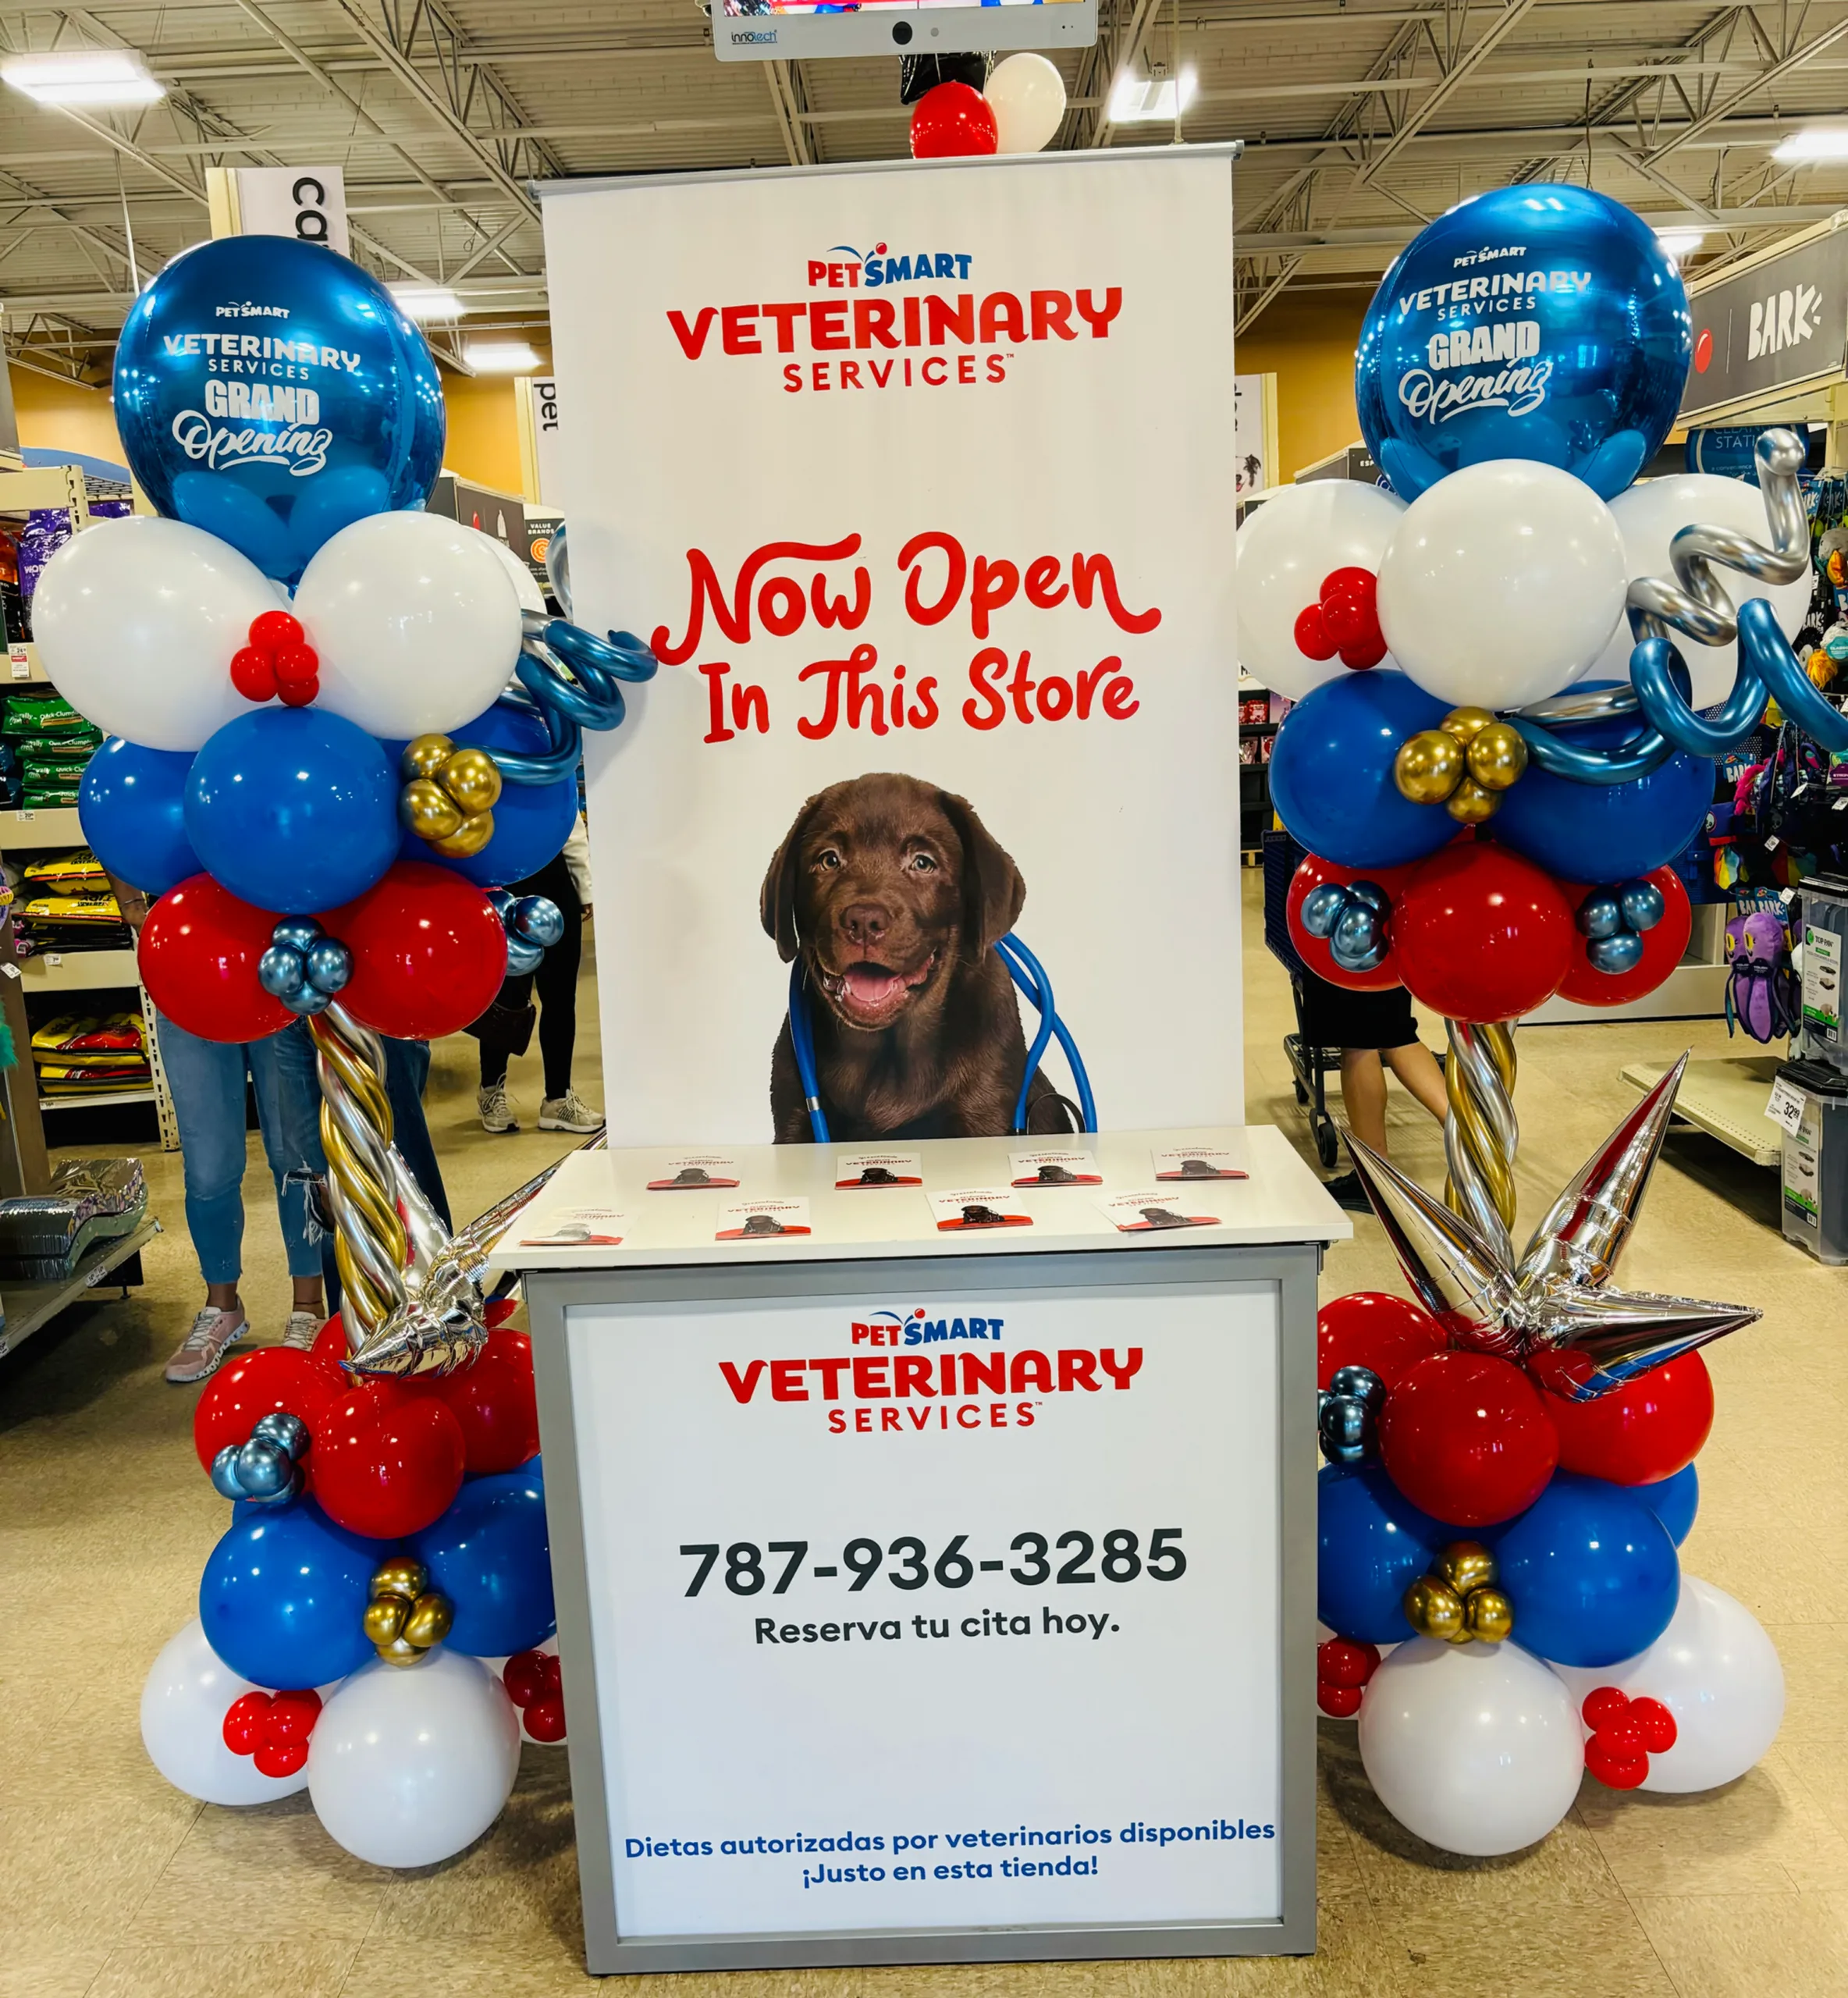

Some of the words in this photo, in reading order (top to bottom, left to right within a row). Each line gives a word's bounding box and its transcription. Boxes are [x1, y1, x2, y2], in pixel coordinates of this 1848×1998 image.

[293, 177, 337, 252] ca
[807, 244, 972, 287] PETSMART
[1453, 247, 1526, 268] PETSMART
[215, 301, 290, 318] PETSMART
[1399, 271, 1591, 316] VETERINARY
[1438, 296, 1536, 322] SERVICES
[666, 286, 1122, 361] VETERINARY
[1747, 284, 1821, 361] BARK
[163, 333, 361, 372] VETERINARY
[1428, 320, 1540, 371] GRAND
[208, 358, 308, 380] SERVICES
[204, 379, 320, 425] GRAND
[1398, 361, 1553, 425] Opening
[172, 410, 333, 476] Opening
[650, 532, 872, 667] Now
[897, 531, 1162, 640] Open
[698, 662, 770, 744] In
[797, 643, 940, 741] This
[961, 646, 1140, 731] Store
[851, 1308, 1004, 1346] PETSMART
[718, 1347, 1143, 1404] VETERINARY
[679, 1527, 1187, 1598] 787-936-3285
[754, 1616, 901, 1644] Reserva
[912, 1615, 949, 1639] tu
[960, 1609, 1031, 1638] cita
[1043, 1606, 1120, 1640] hoy.
[625, 1836, 713, 1858] Dietas
[720, 1831, 885, 1855] autorizadas
[893, 1833, 938, 1854] por
[945, 1824, 1112, 1848] veterinarios
[1119, 1818, 1275, 1847] disponibles
[802, 1863, 885, 1890] ¡Justo
[893, 1865, 926, 1881] en
[933, 1861, 993, 1879] esta
[1000, 1855, 1099, 1878] tienda!
